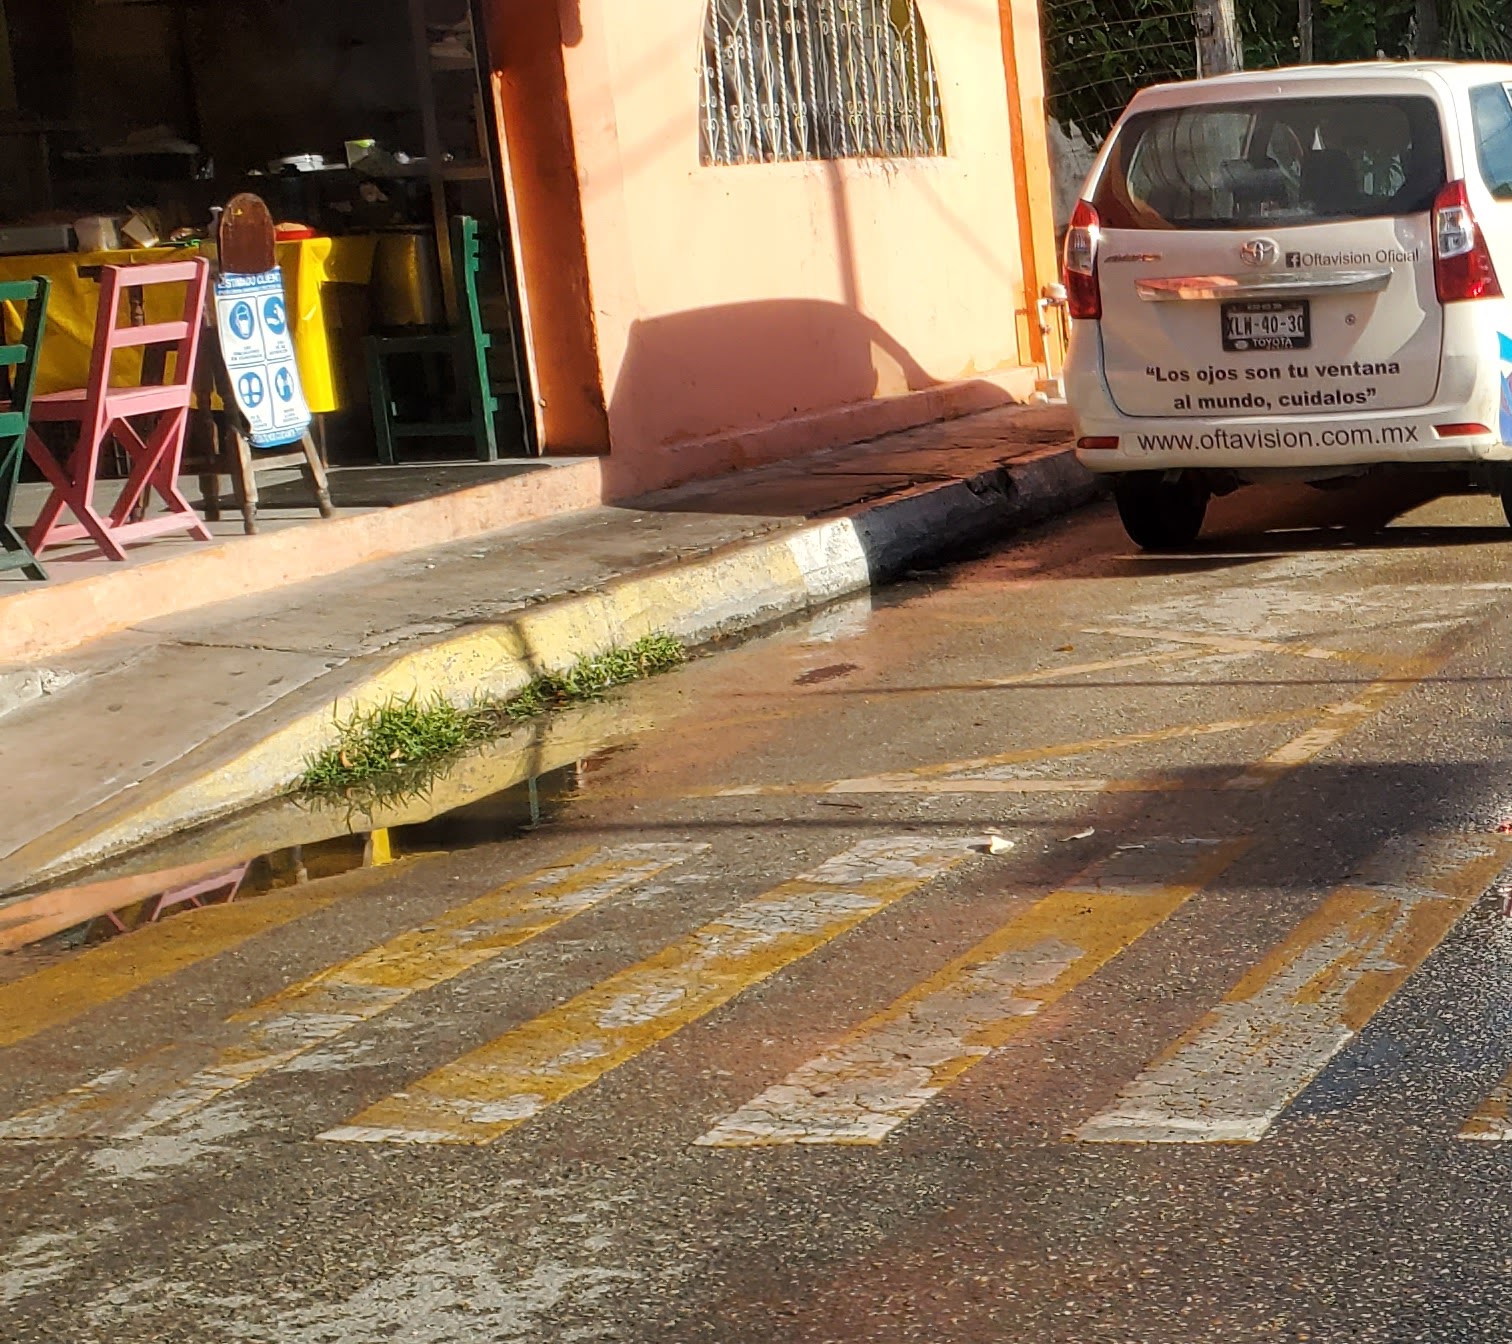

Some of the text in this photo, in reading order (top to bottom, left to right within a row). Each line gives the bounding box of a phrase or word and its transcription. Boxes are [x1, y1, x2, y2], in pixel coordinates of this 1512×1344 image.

[1302, 250, 1371, 267] Oftavision
[1375, 247, 1419, 264] Oficial
[1252, 337, 1294, 349] TOYOTA
[1197, 365, 1238, 384] ojos
[1245, 366, 1281, 380] son
[1288, 364, 1308, 379] tu
[1315, 361, 1400, 377] ventana
[1174, 394, 1191, 410] al
[1198, 392, 1272, 410] mundo,
[1137, 424, 1419, 452] www.oftavision.com.mx
